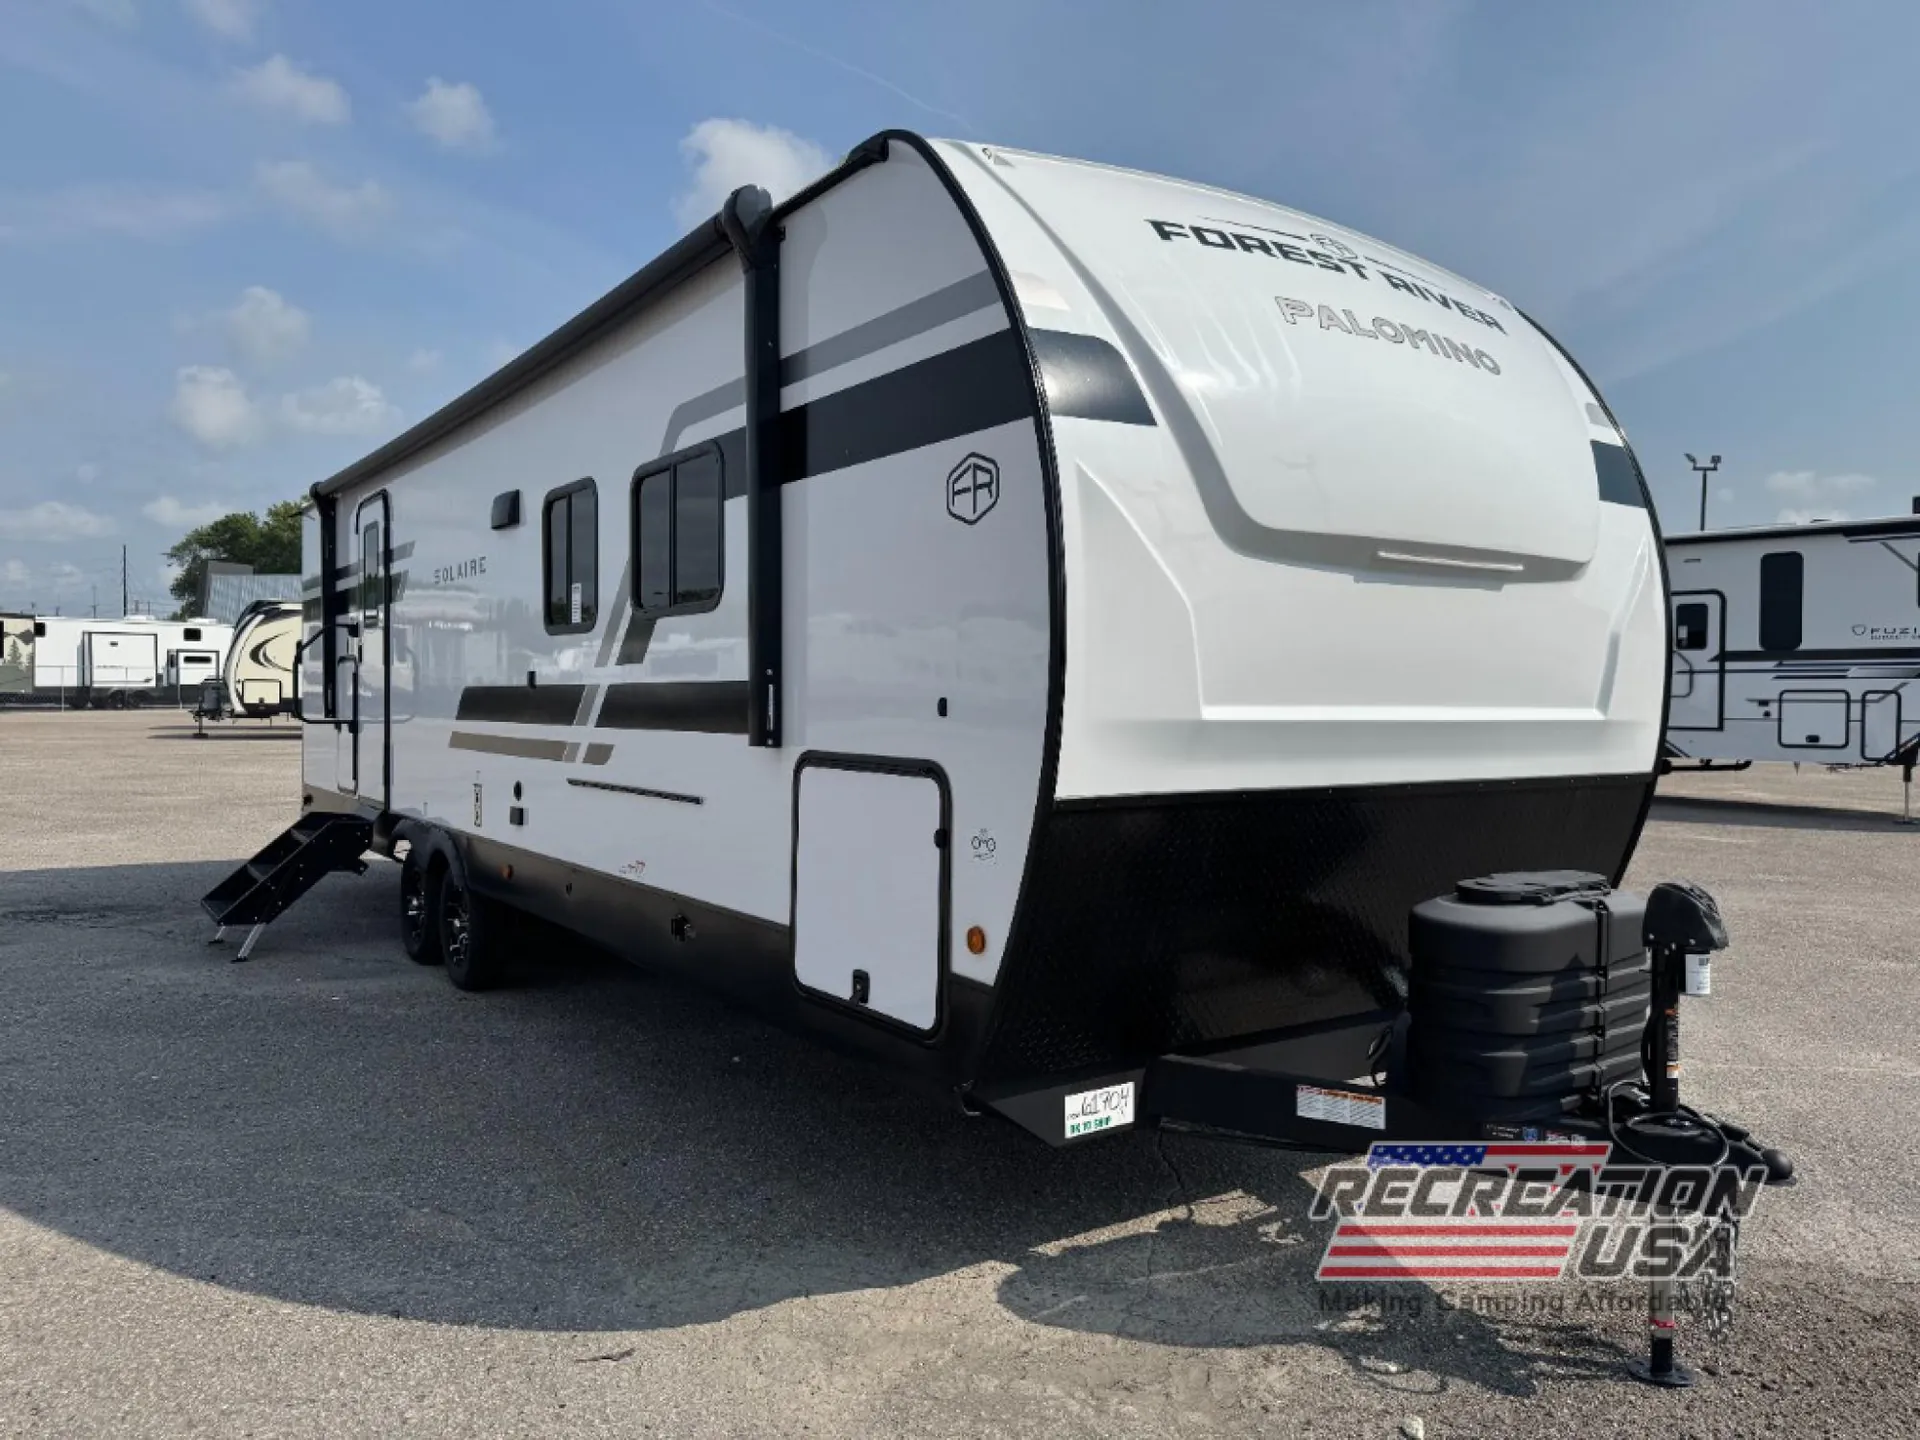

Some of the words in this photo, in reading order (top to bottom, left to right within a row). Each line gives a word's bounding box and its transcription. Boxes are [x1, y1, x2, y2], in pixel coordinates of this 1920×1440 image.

[1145, 219, 1369, 280] FOREST
[1378, 271, 1509, 336] RIVER
[1275, 296, 1501, 376] PALOMINO
[433, 555, 486, 584] SOLAIRE
